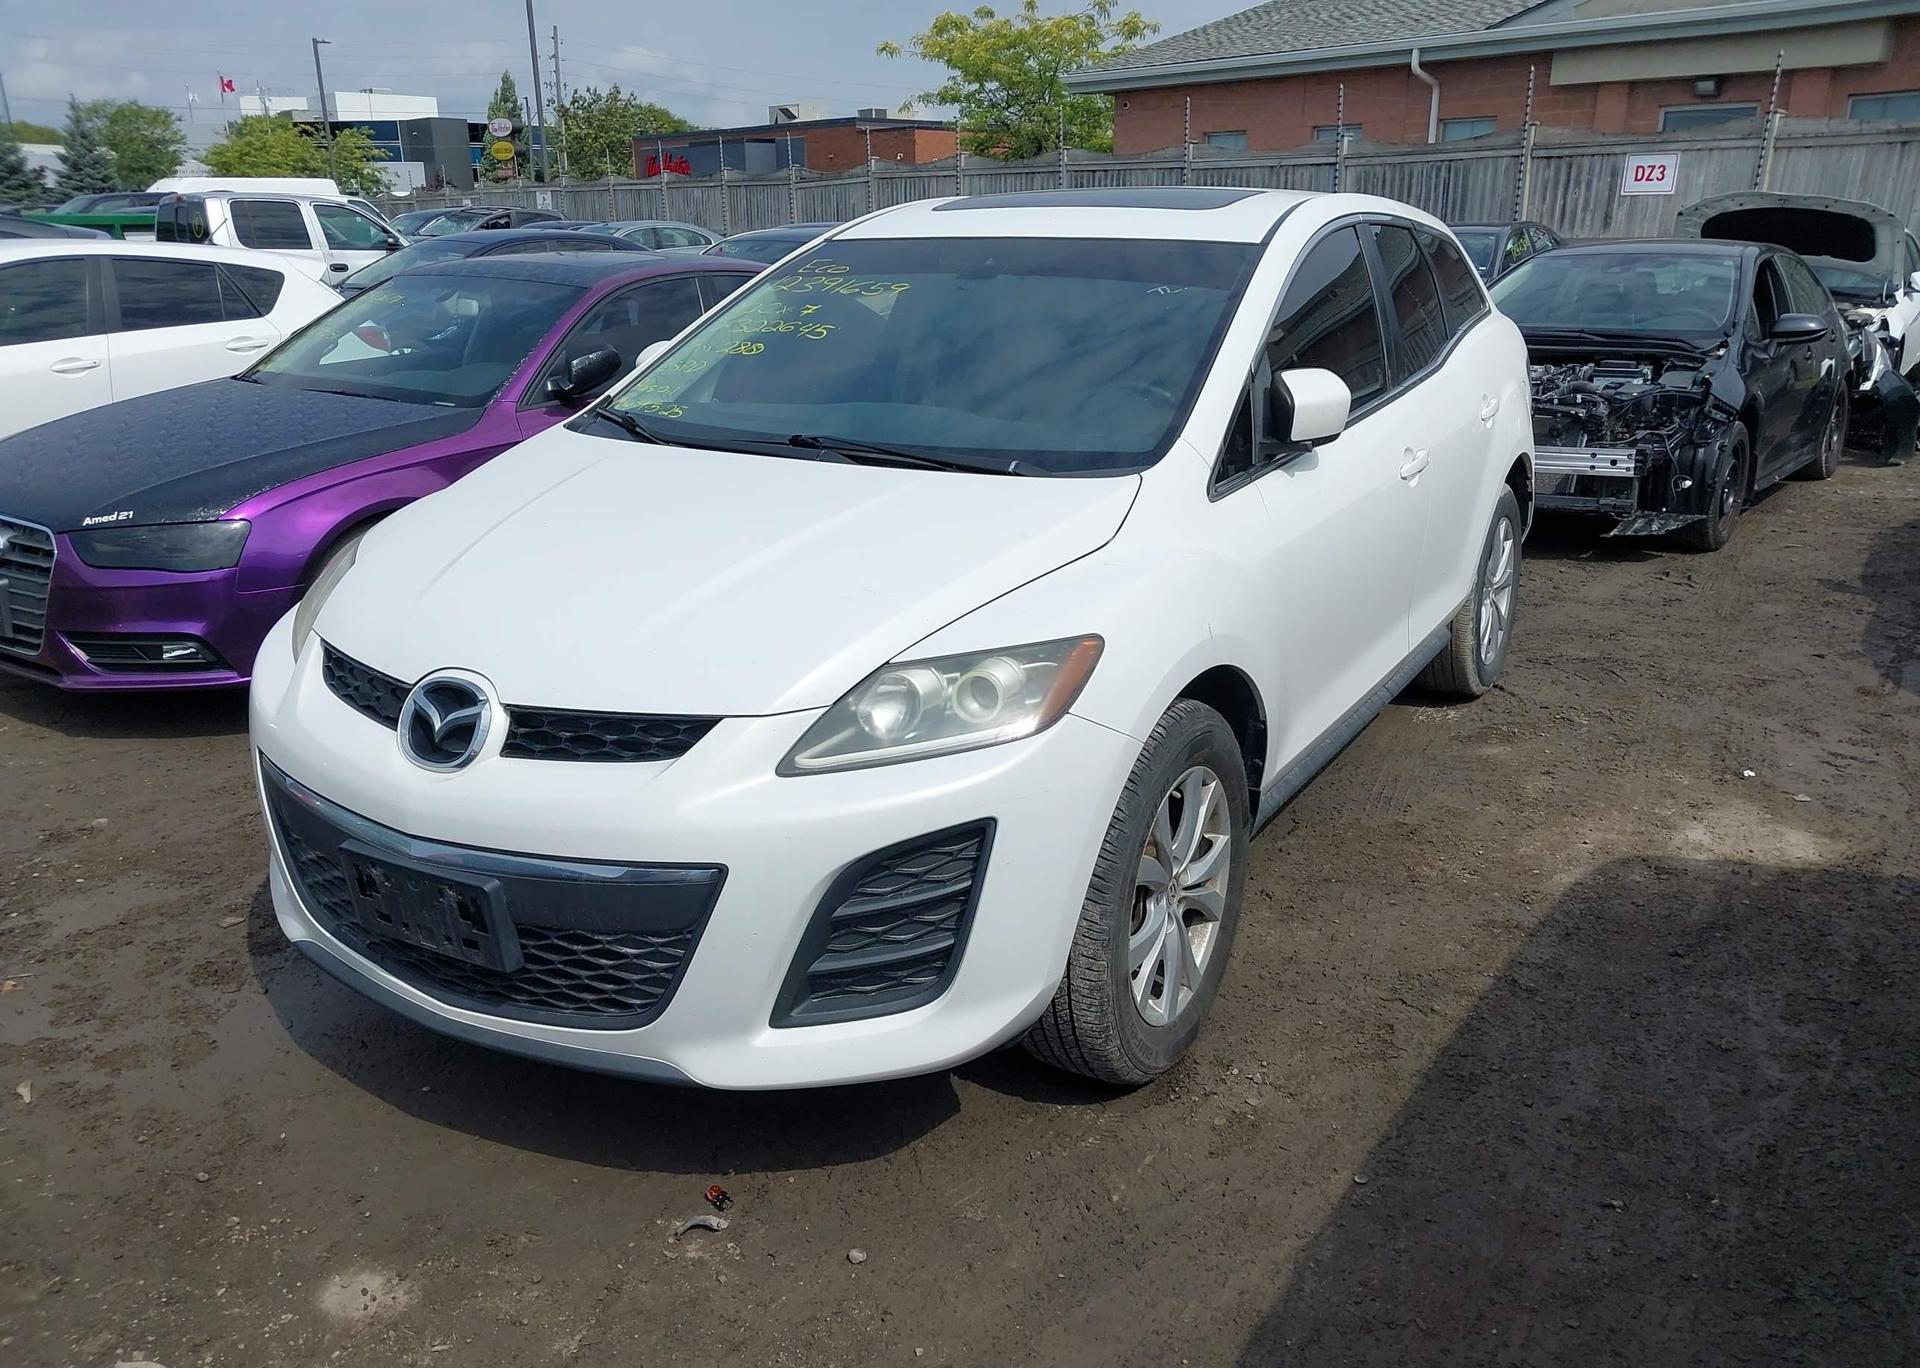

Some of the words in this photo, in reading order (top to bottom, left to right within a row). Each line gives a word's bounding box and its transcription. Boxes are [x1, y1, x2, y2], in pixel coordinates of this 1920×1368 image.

[1634, 164, 1667, 182] DZ3
[799, 304, 822, 316] 7
[82, 511, 118, 526] Amed
[118, 510, 134, 520] 21
